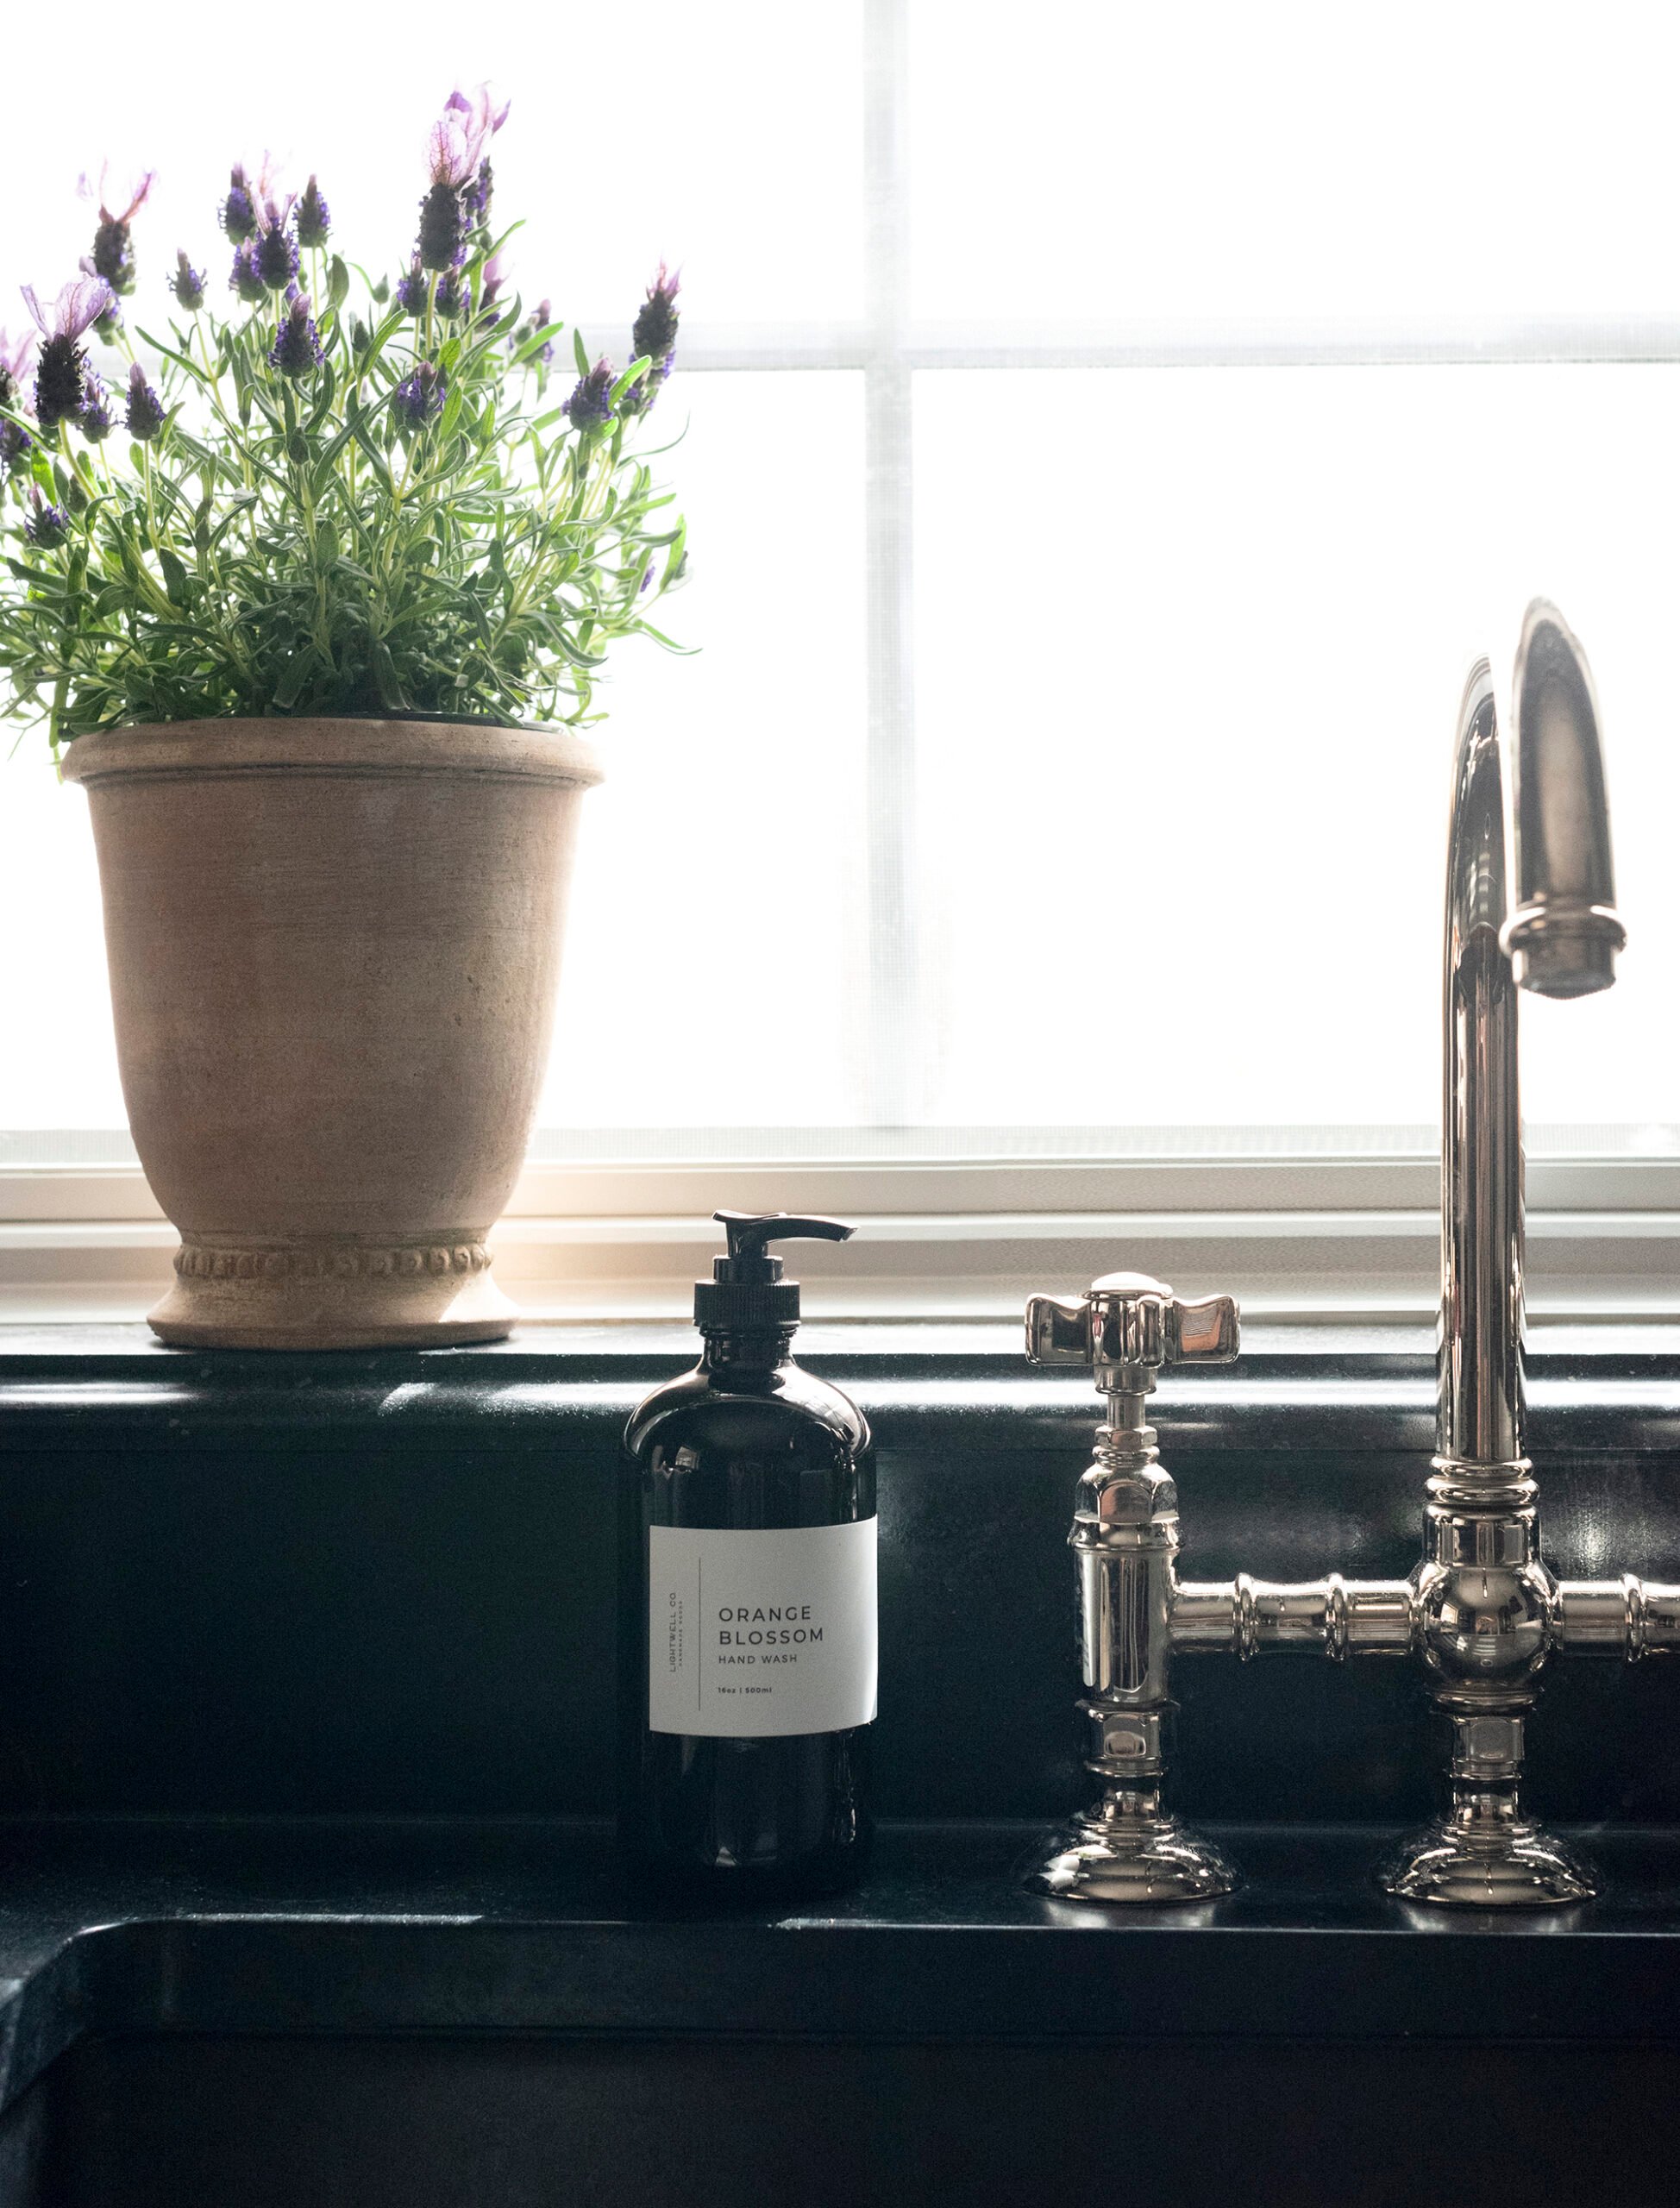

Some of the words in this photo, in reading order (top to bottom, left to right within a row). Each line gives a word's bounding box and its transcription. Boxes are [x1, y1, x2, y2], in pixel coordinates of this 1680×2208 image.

[669, 1593, 676, 1608] CO
[718, 1606, 812, 1622] ORANGE
[719, 1628, 823, 1645] BLOSSOM
[718, 1655, 755, 1664] HAND
[762, 1654, 798, 1664] WASH
